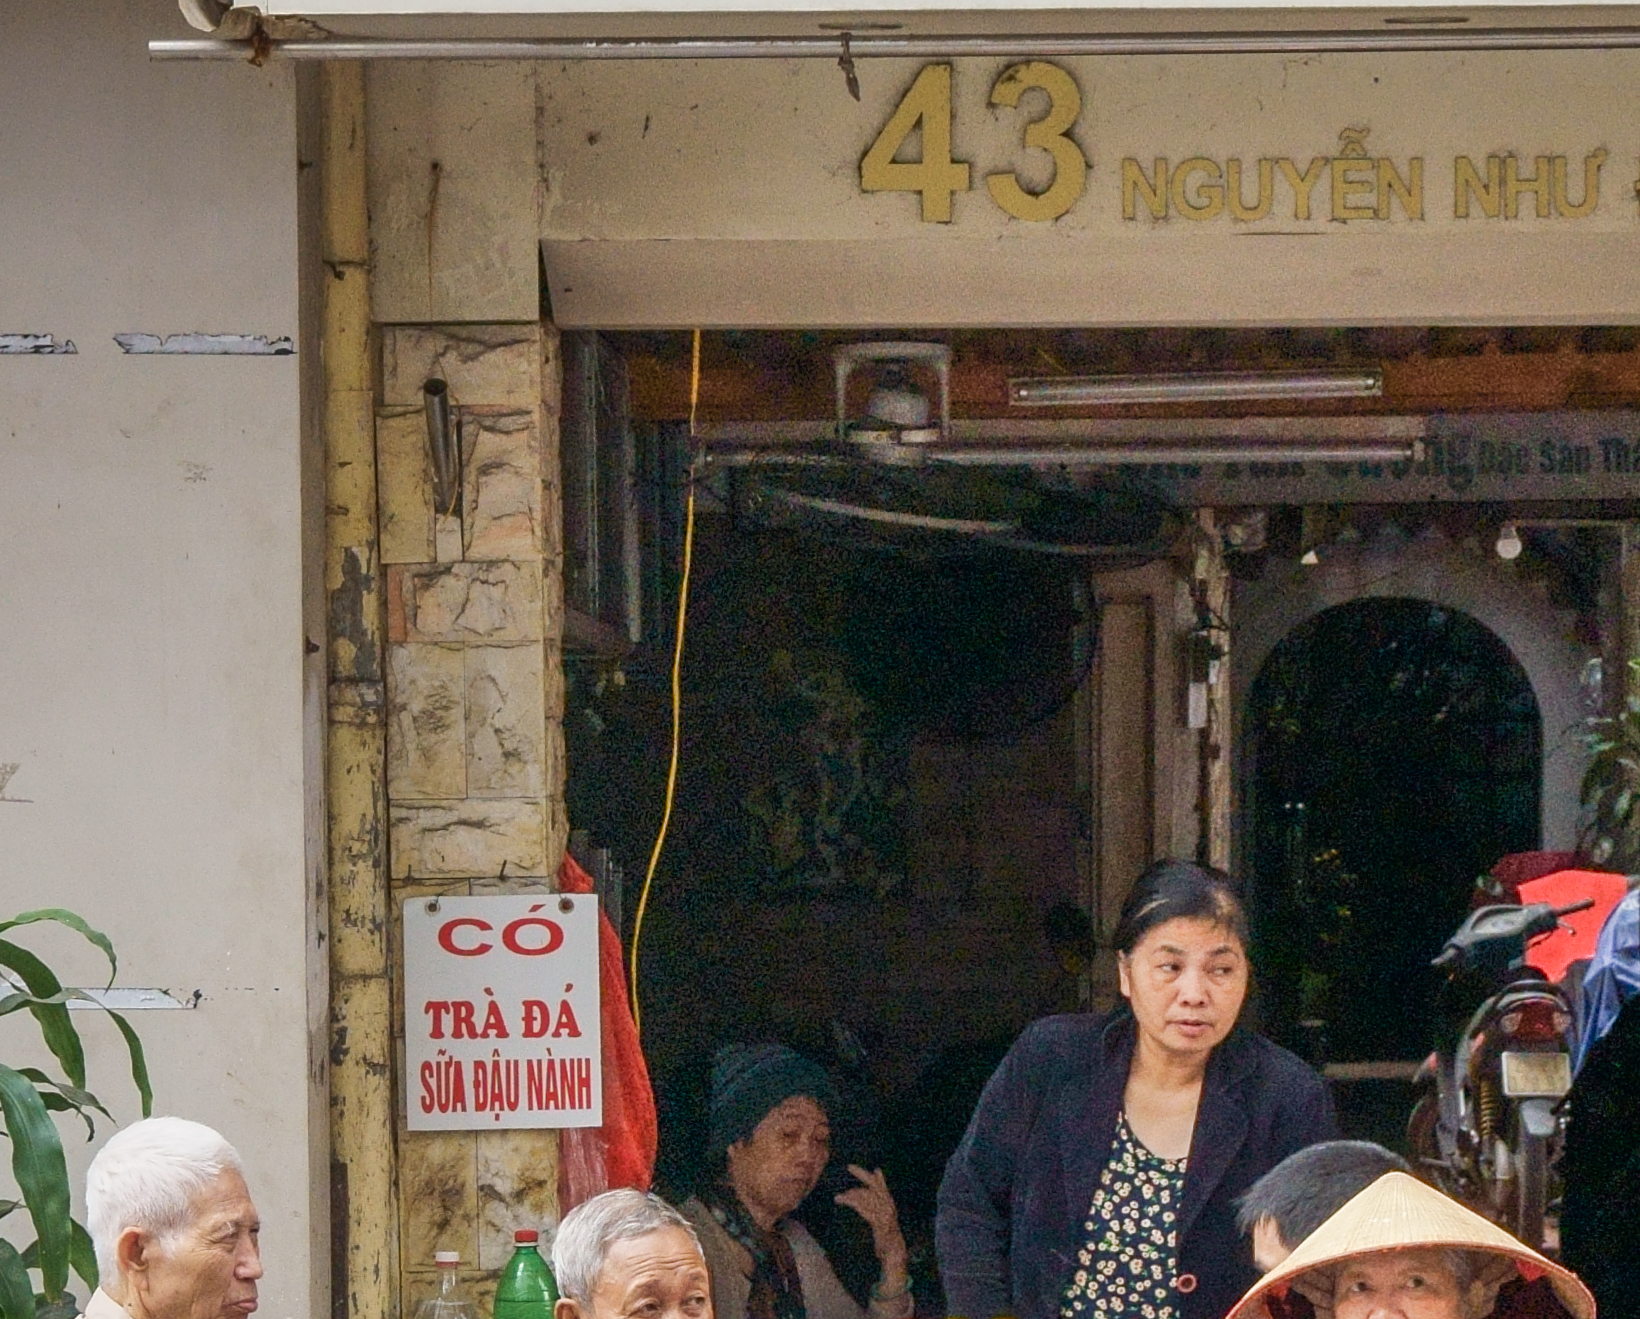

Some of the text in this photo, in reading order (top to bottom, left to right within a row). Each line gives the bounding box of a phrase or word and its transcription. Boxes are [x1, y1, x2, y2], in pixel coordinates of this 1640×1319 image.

[859, 61, 1088, 224] 43
[1121, 128, 1422, 222] NGUYỄN
[1453, 147, 1607, 220] NHƯ
[438, 904, 564, 957] CÓ
[425, 983, 582, 1040] TRÀ ĐÁ
[420, 1047, 592, 1121] SỮA ĐẬU NÀNH
